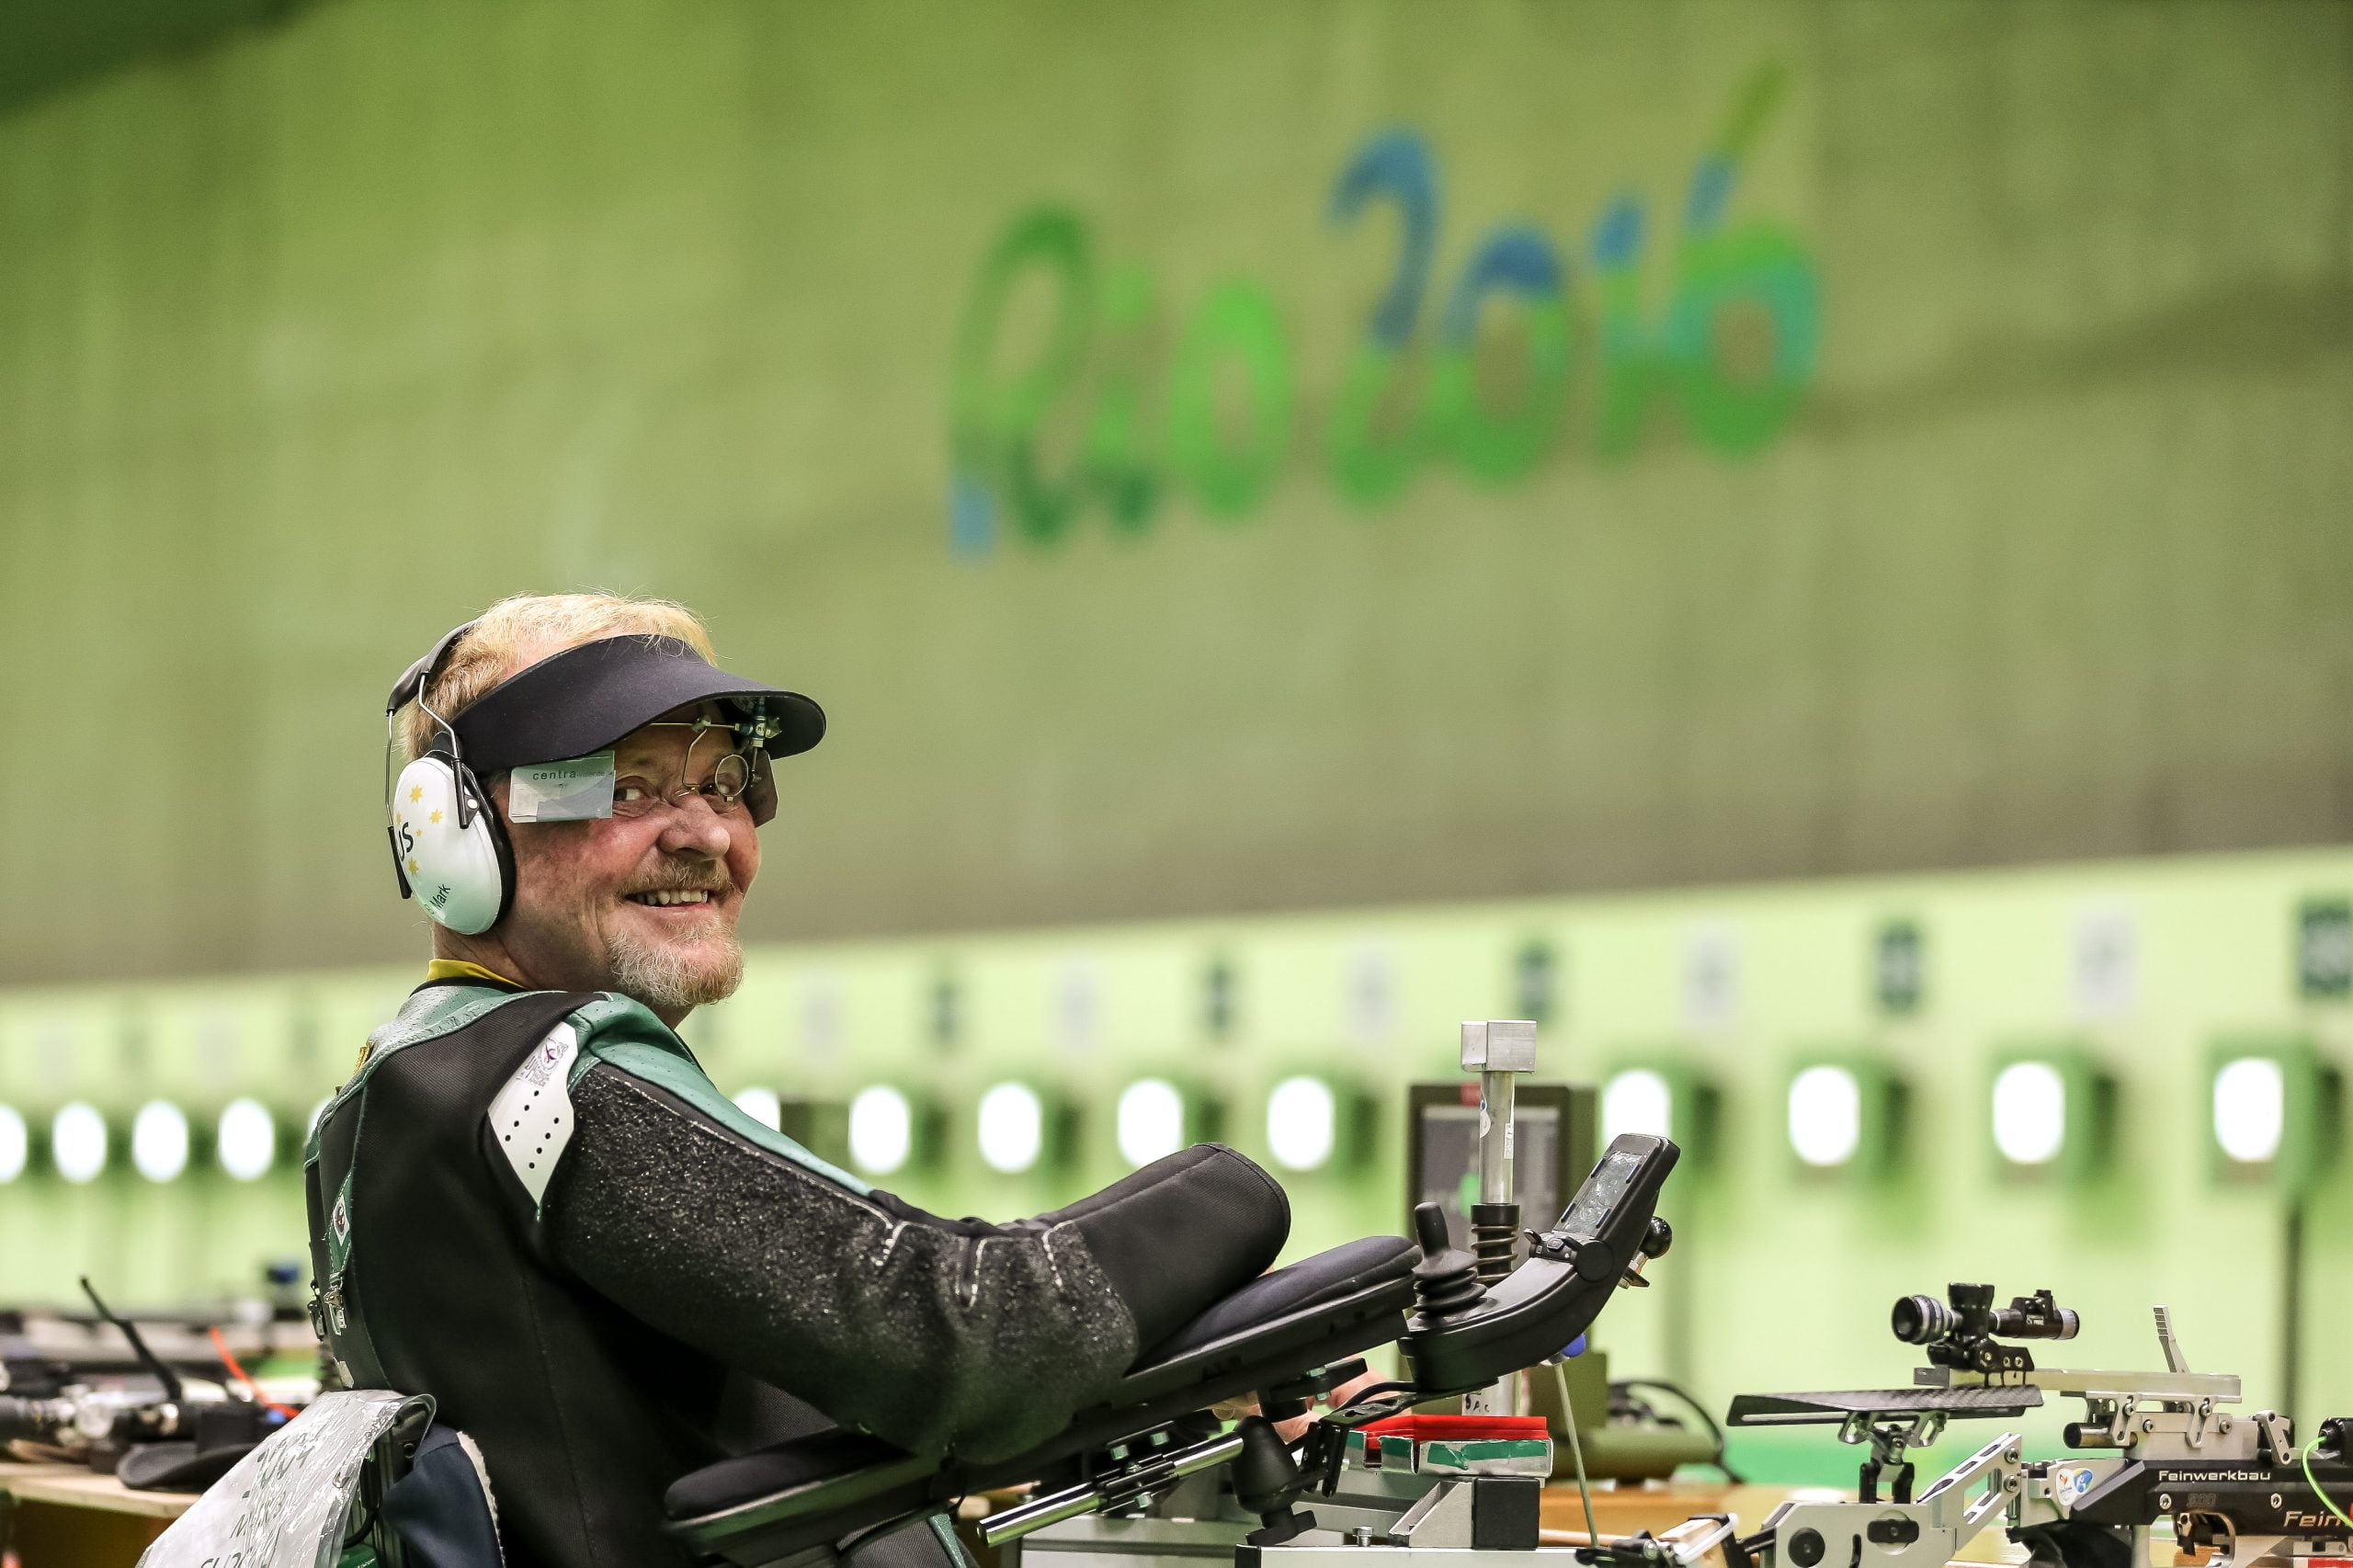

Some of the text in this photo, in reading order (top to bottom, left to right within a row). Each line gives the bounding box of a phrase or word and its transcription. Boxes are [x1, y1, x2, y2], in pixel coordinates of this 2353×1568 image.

[949, 61, 1820, 561] Rio 2016
[532, 770, 576, 780] centra
[429, 883, 451, 911] Mark
[2158, 1470, 2271, 1482] Feinwerkbau
[2283, 1510, 2351, 1528] Fein
